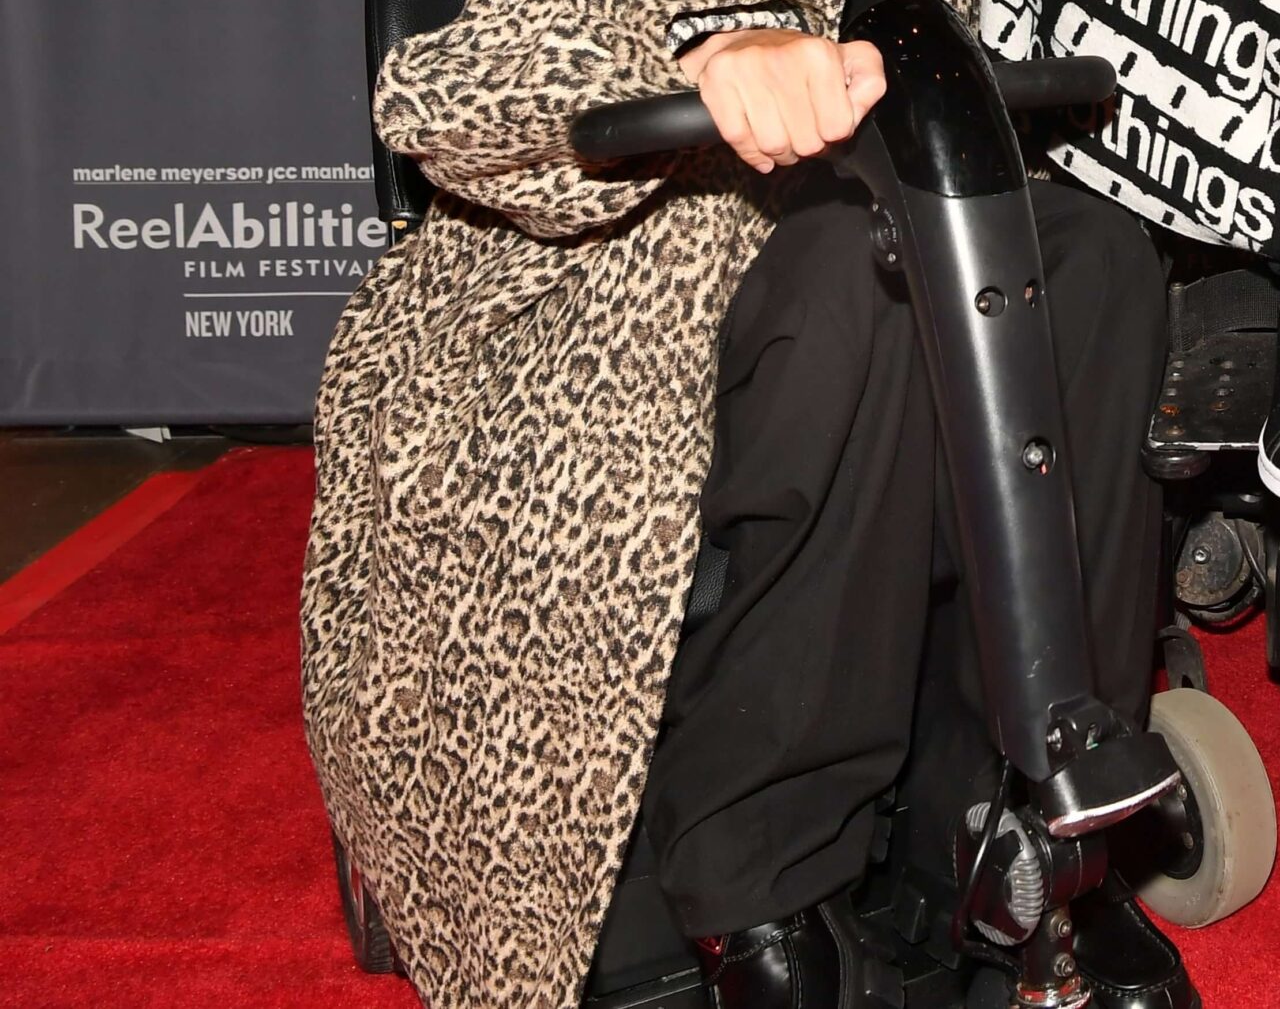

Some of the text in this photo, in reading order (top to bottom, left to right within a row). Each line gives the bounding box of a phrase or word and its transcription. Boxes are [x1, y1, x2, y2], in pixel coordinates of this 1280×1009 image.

[73, 165, 157, 181] marlene
[160, 167, 263, 184] meyerson
[266, 166, 297, 183] jcc
[184, 261, 245, 278] FILM
[185, 310, 294, 337] NEW YORK
